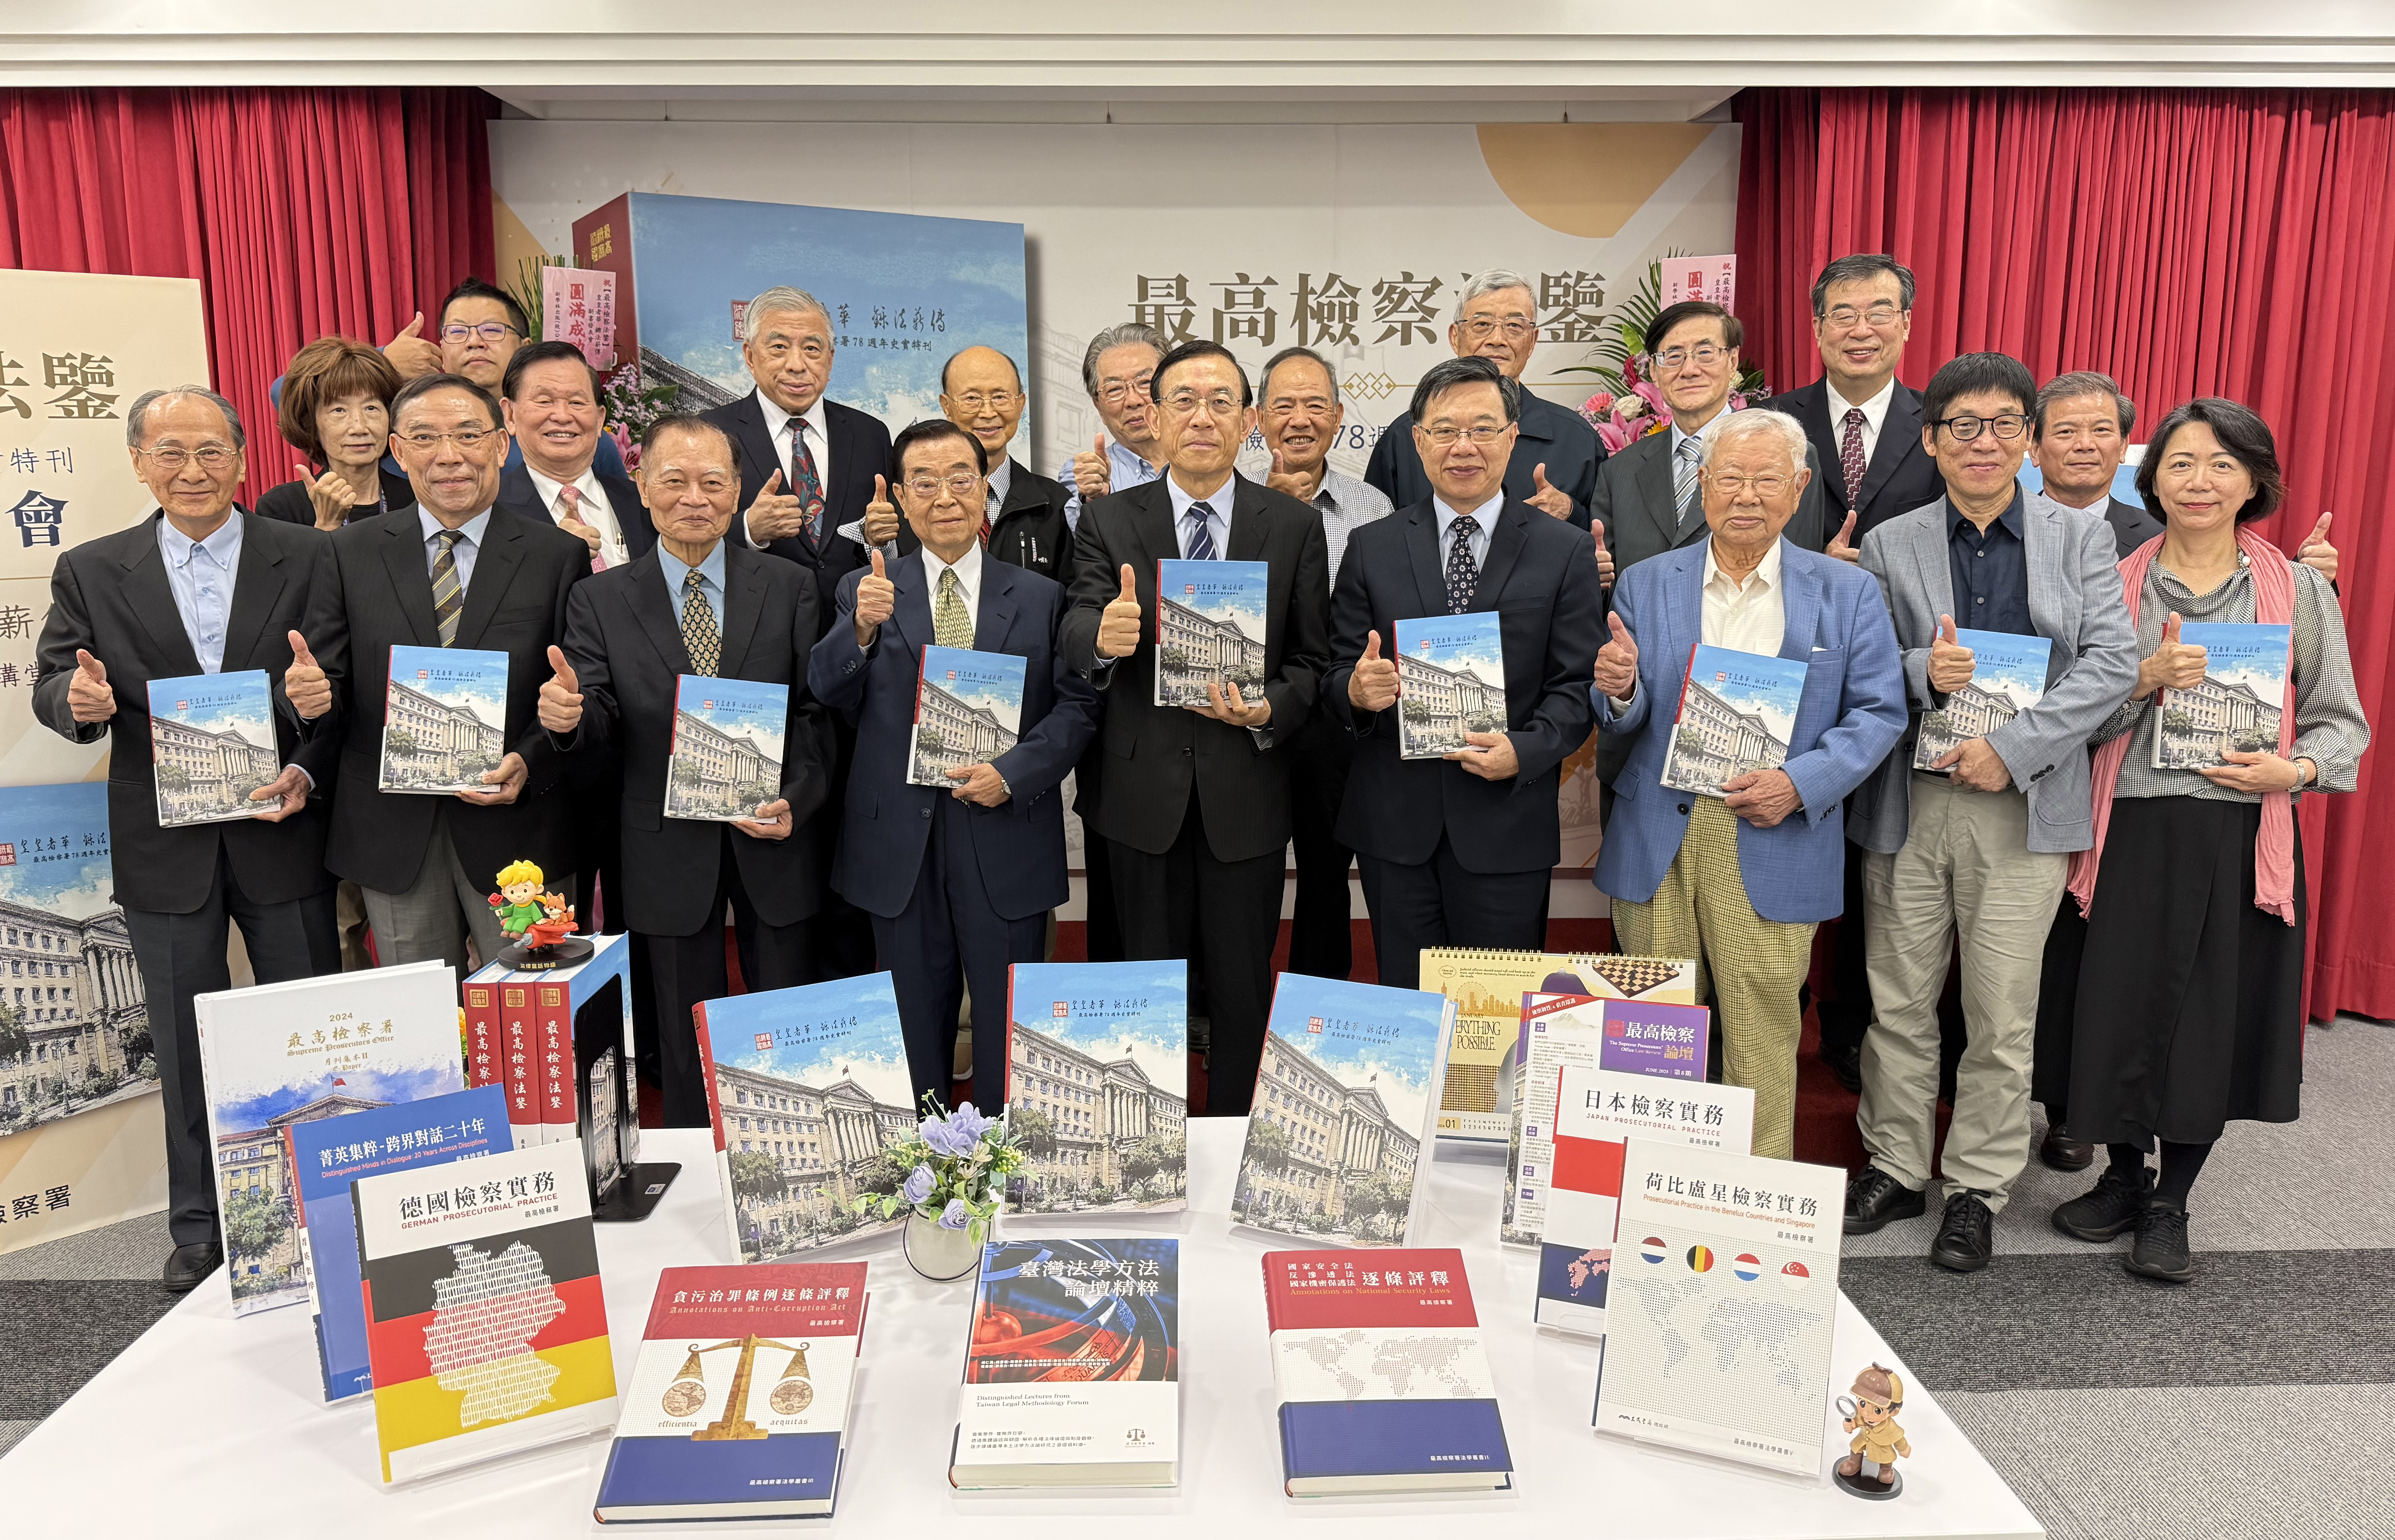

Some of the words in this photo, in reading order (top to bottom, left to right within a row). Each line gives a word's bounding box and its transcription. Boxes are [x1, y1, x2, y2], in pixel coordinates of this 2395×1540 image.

[1687, 271, 1704, 302] 圓滿
[1128, 271, 1605, 347] 最高檢察鑒
[0, 447, 73, 474] 特刊
[5, 489, 69, 547] 會
[329, 1012, 353, 1022] 2024
[287, 1019, 393, 1048] 最高檢察署
[1455, 1020, 1501, 1036] ERYTHING
[1626, 1022, 1696, 1043] 最高檢察
[287, 1047, 323, 1057] Supreme
[325, 1039, 370, 1052] Prosecutors
[372, 1035, 394, 1044] Office
[475, 1022, 491, 1088] 最高檢察
[1664, 1045, 1694, 1061] 論壇
[1586, 1089, 1724, 1127] 日本檢察實務
[1445, 1119, 1456, 1129] 01
[1586, 1112, 1609, 1121] JAPAN
[1614, 1116, 1676, 1131] PROSECUTORIAL
[1682, 1126, 1721, 1137] PRACTICE
[318, 1118, 486, 1168] 菁英集粹-跨界對話二十年
[1689, 1138, 1721, 1148] 最高檢察署
[321, 1164, 361, 1179] Distinguished
[362, 1162, 379, 1171] Minds
[422, 1149, 438, 1157] Years
[439, 1144, 457, 1154] Across
[458, 1138, 488, 1149] Disciplines
[399, 1171, 555, 1220] 德國檢察實務
[1645, 1172, 1818, 1217] 荷比盧星檢察實務
[402, 1216, 439, 1229] GERMAN
[443, 1202, 513, 1221] PROSECUTORIAL
[517, 1193, 558, 1207] PRACTICE
[524, 1205, 559, 1218] 最高檢察署
[1643, 1194, 1680, 1206] Prosecutorial
[1680, 1200, 1704, 1211] Practice
[1722, 1207, 1744, 1217] Benelux
[1745, 1211, 1773, 1223] Countries
[1786, 1218, 1815, 1229] Singapore
[1777, 1231, 1814, 1243] 最高檢察署
[1018, 1259, 1160, 1278] 臺灣法學方法
[1288, 1262, 1353, 1270] 國家安全法
[1289, 1270, 1355, 1279] 反滲透法
[1289, 1279, 1356, 1288] 國家機密保護法
[1361, 1270, 1449, 1287] 逐條評釋
[672, 1287, 850, 1304] 貪污治罪條例逐條評釋
[1065, 1279, 1159, 1297] 論壇精粹
[1393, 1287, 1427, 1295] Security
[669, 1305, 728, 1314] Annotations
[747, 1304, 827, 1313] Anti-Corruption
[829, 1303, 846, 1311] Act
[809, 1319, 845, 1327] 最高檢察署
[658, 1420, 698, 1428] efficientia
[770, 1418, 809, 1426] aequitas
